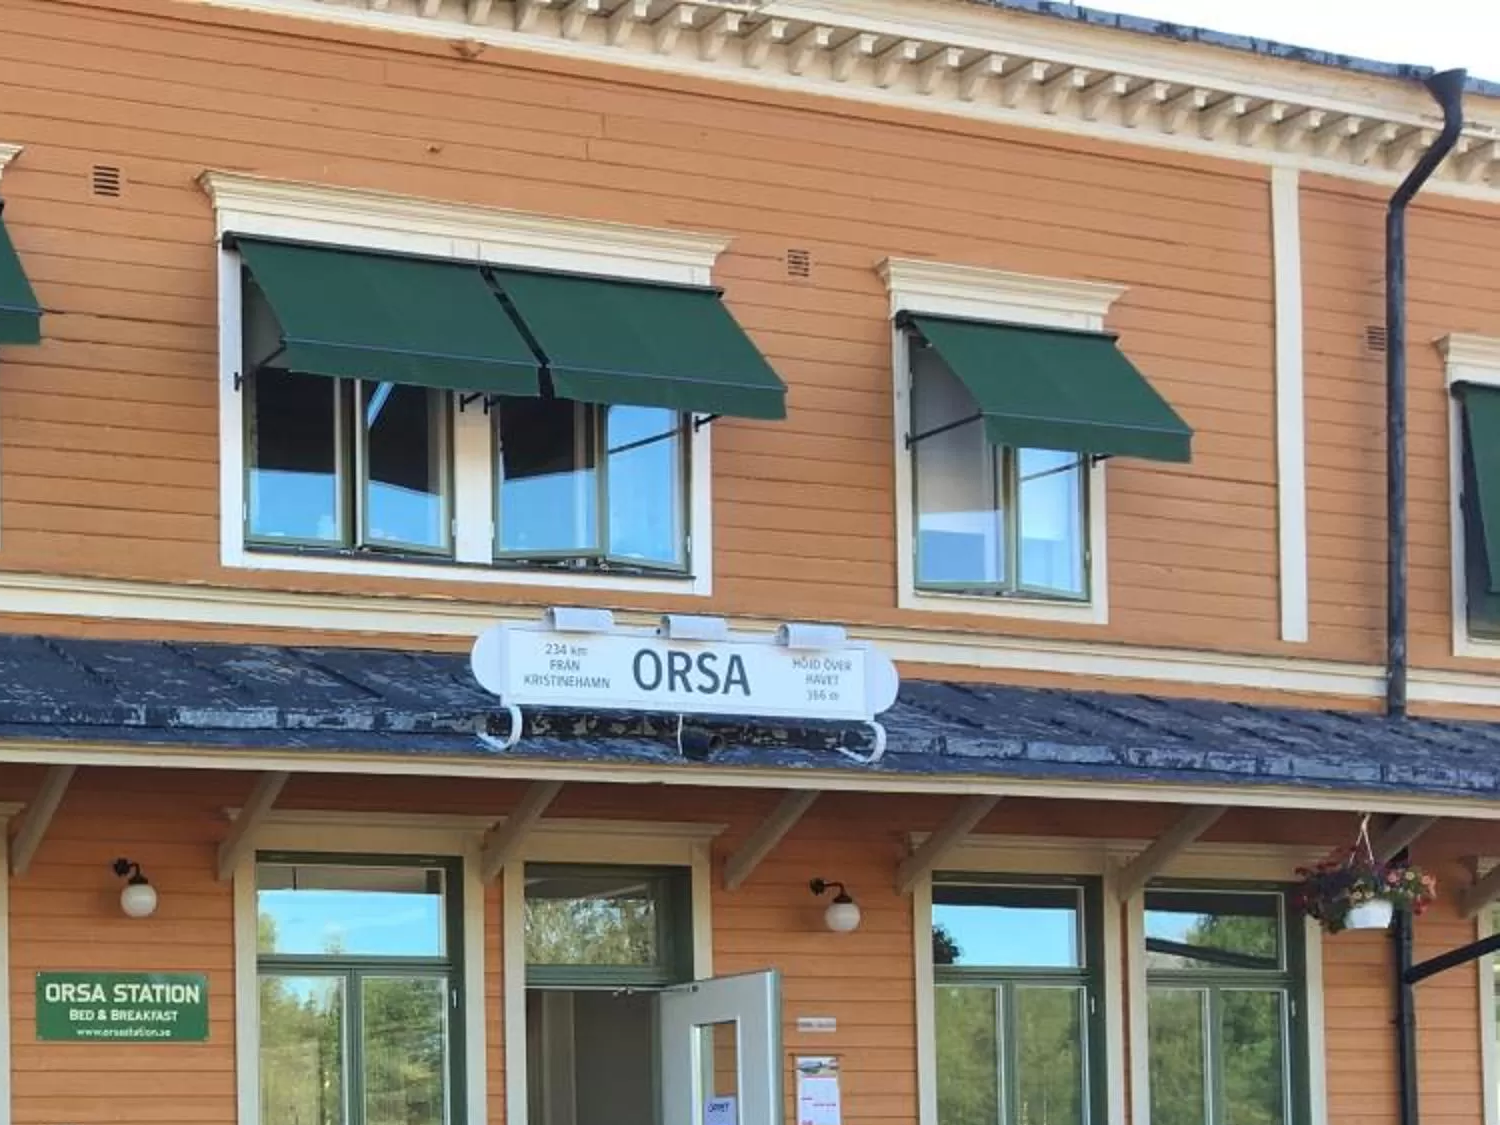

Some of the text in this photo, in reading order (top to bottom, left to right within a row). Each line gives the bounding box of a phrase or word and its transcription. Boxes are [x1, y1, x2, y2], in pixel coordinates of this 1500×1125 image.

[544, 643, 588, 656] 234 km
[549, 657, 580, 671] FRÅN
[632, 648, 751, 697] ORSA
[523, 673, 611, 689] KRISTINEHAMN
[45, 983, 200, 1004] ORSA STATION
[69, 1009, 178, 1022] BED & BREAKFAST
[76, 1026, 171, 1037] www.orsastation.se
